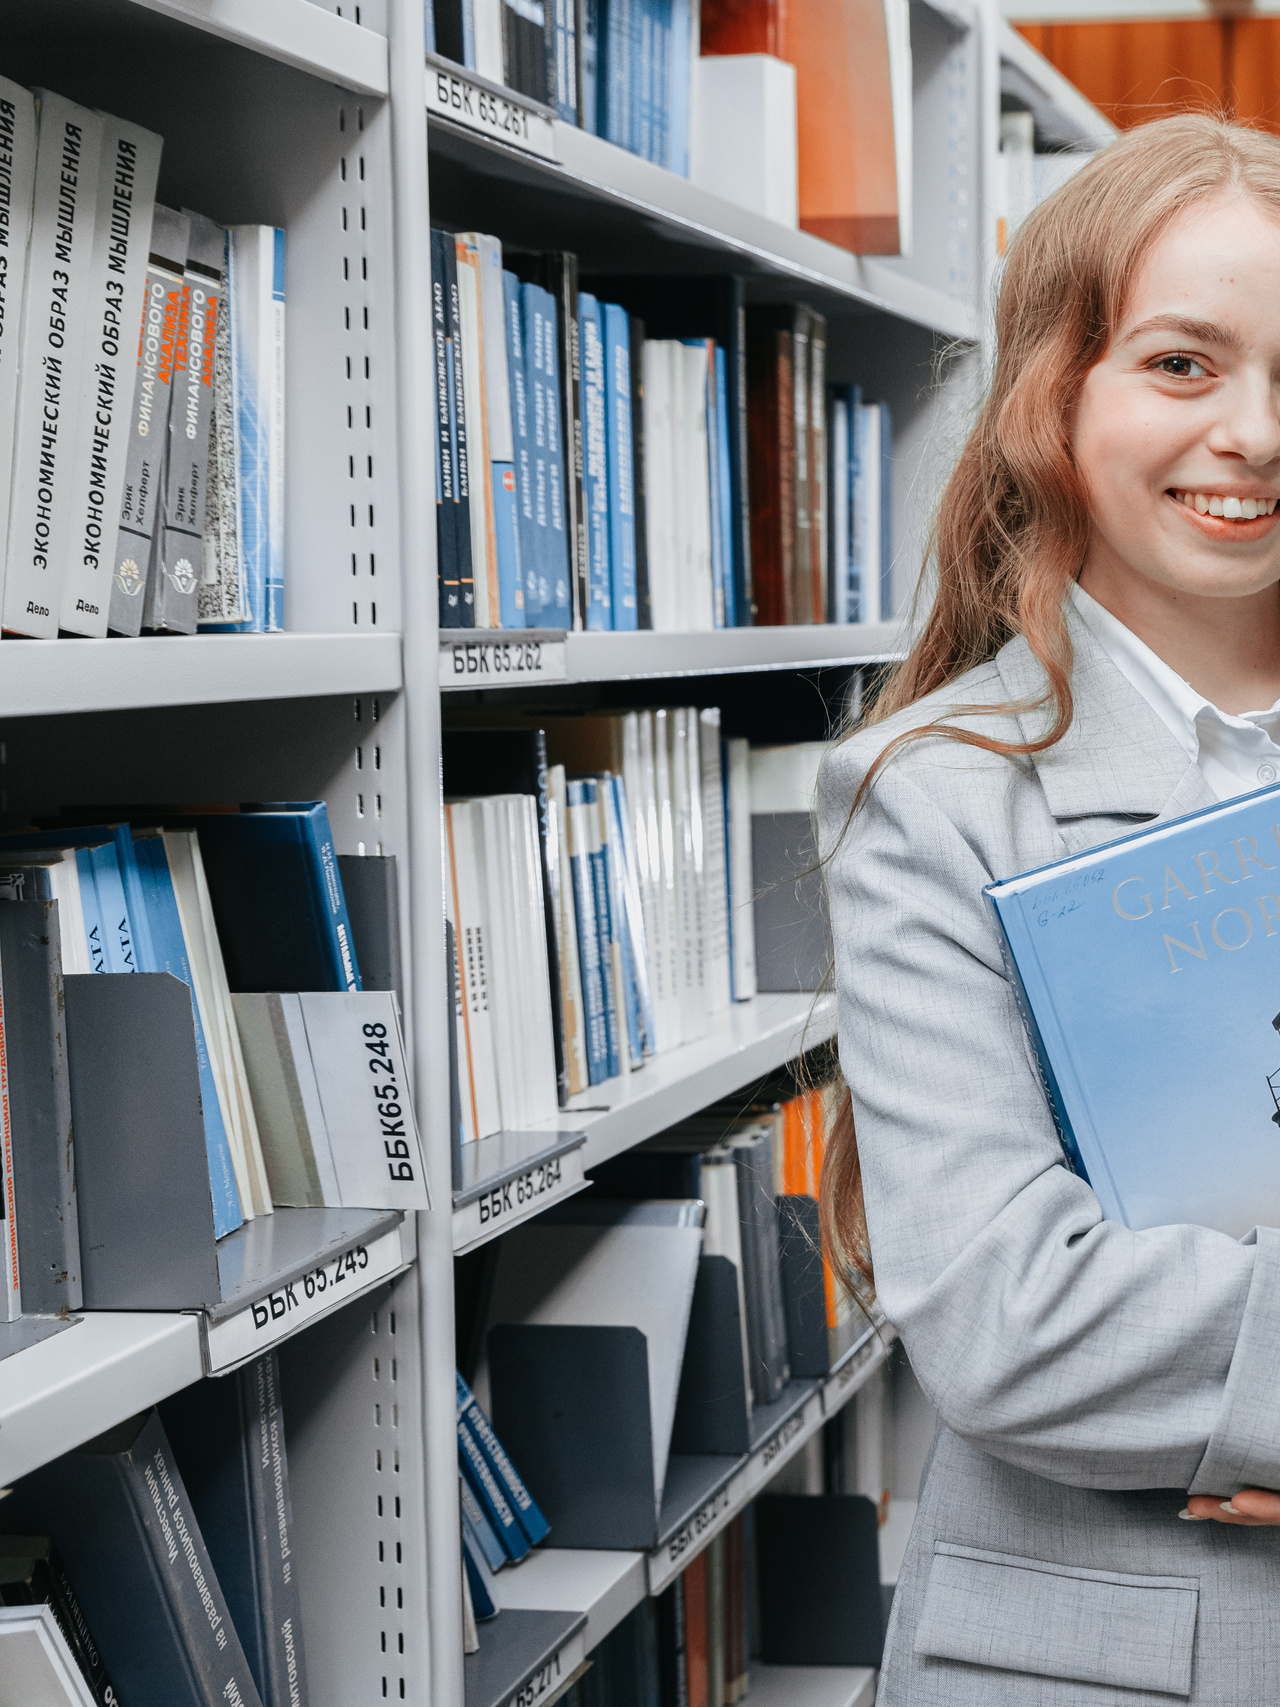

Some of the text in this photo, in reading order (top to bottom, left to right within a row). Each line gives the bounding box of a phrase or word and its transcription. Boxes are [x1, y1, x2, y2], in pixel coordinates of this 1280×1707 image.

[437, 73, 529, 139] ББК 65.261
[33, 122, 82, 570] ЭКОНОМИЧЕСКИЙ ОБРАЗ МЫШЛЕНИЯ
[84, 138, 137, 570] ЭКОНОМИЧЕСКИЙ ОБРАЗ МЫШЛЕНИЯ
[138, 282, 165, 437] ФИНАНСОВОГО
[158, 291, 180, 385] АНАЛИЗА
[174, 286, 191, 372] ТЕХНИКА
[186, 289, 206, 440] ФИНАНСОВОГО
[201, 297, 218, 388] АНАЛИЗА
[122, 483, 134, 521] Эрик
[135, 460, 150, 526] Хелферт
[175, 486, 185, 522] Эрик
[442, 448, 453, 498] БАНКИ
[459, 448, 469, 497] БАНКИ
[26, 601, 50, 617] Дело
[76, 598, 99, 615] Дело
[453, 643, 542, 673] ББК 65.262
[3, 1094, 13, 1173] ПОТЕНЦИАЛ
[362, 1021, 415, 1182] ББК65.248
[7, 1174, 19, 1290] ЭКОНОМИЧЕСКИЙ
[478, 1158, 562, 1224] ББК 65.264
[250, 1243, 369, 1330] ББК 65.245
[258, 1362, 270, 1468] Инвестиции
[266, 1353, 292, 1584] на развивающихся рынках
[145, 1465, 178, 1564] Инвестиции
[154, 1447, 228, 1652] на развивающихся рынках
